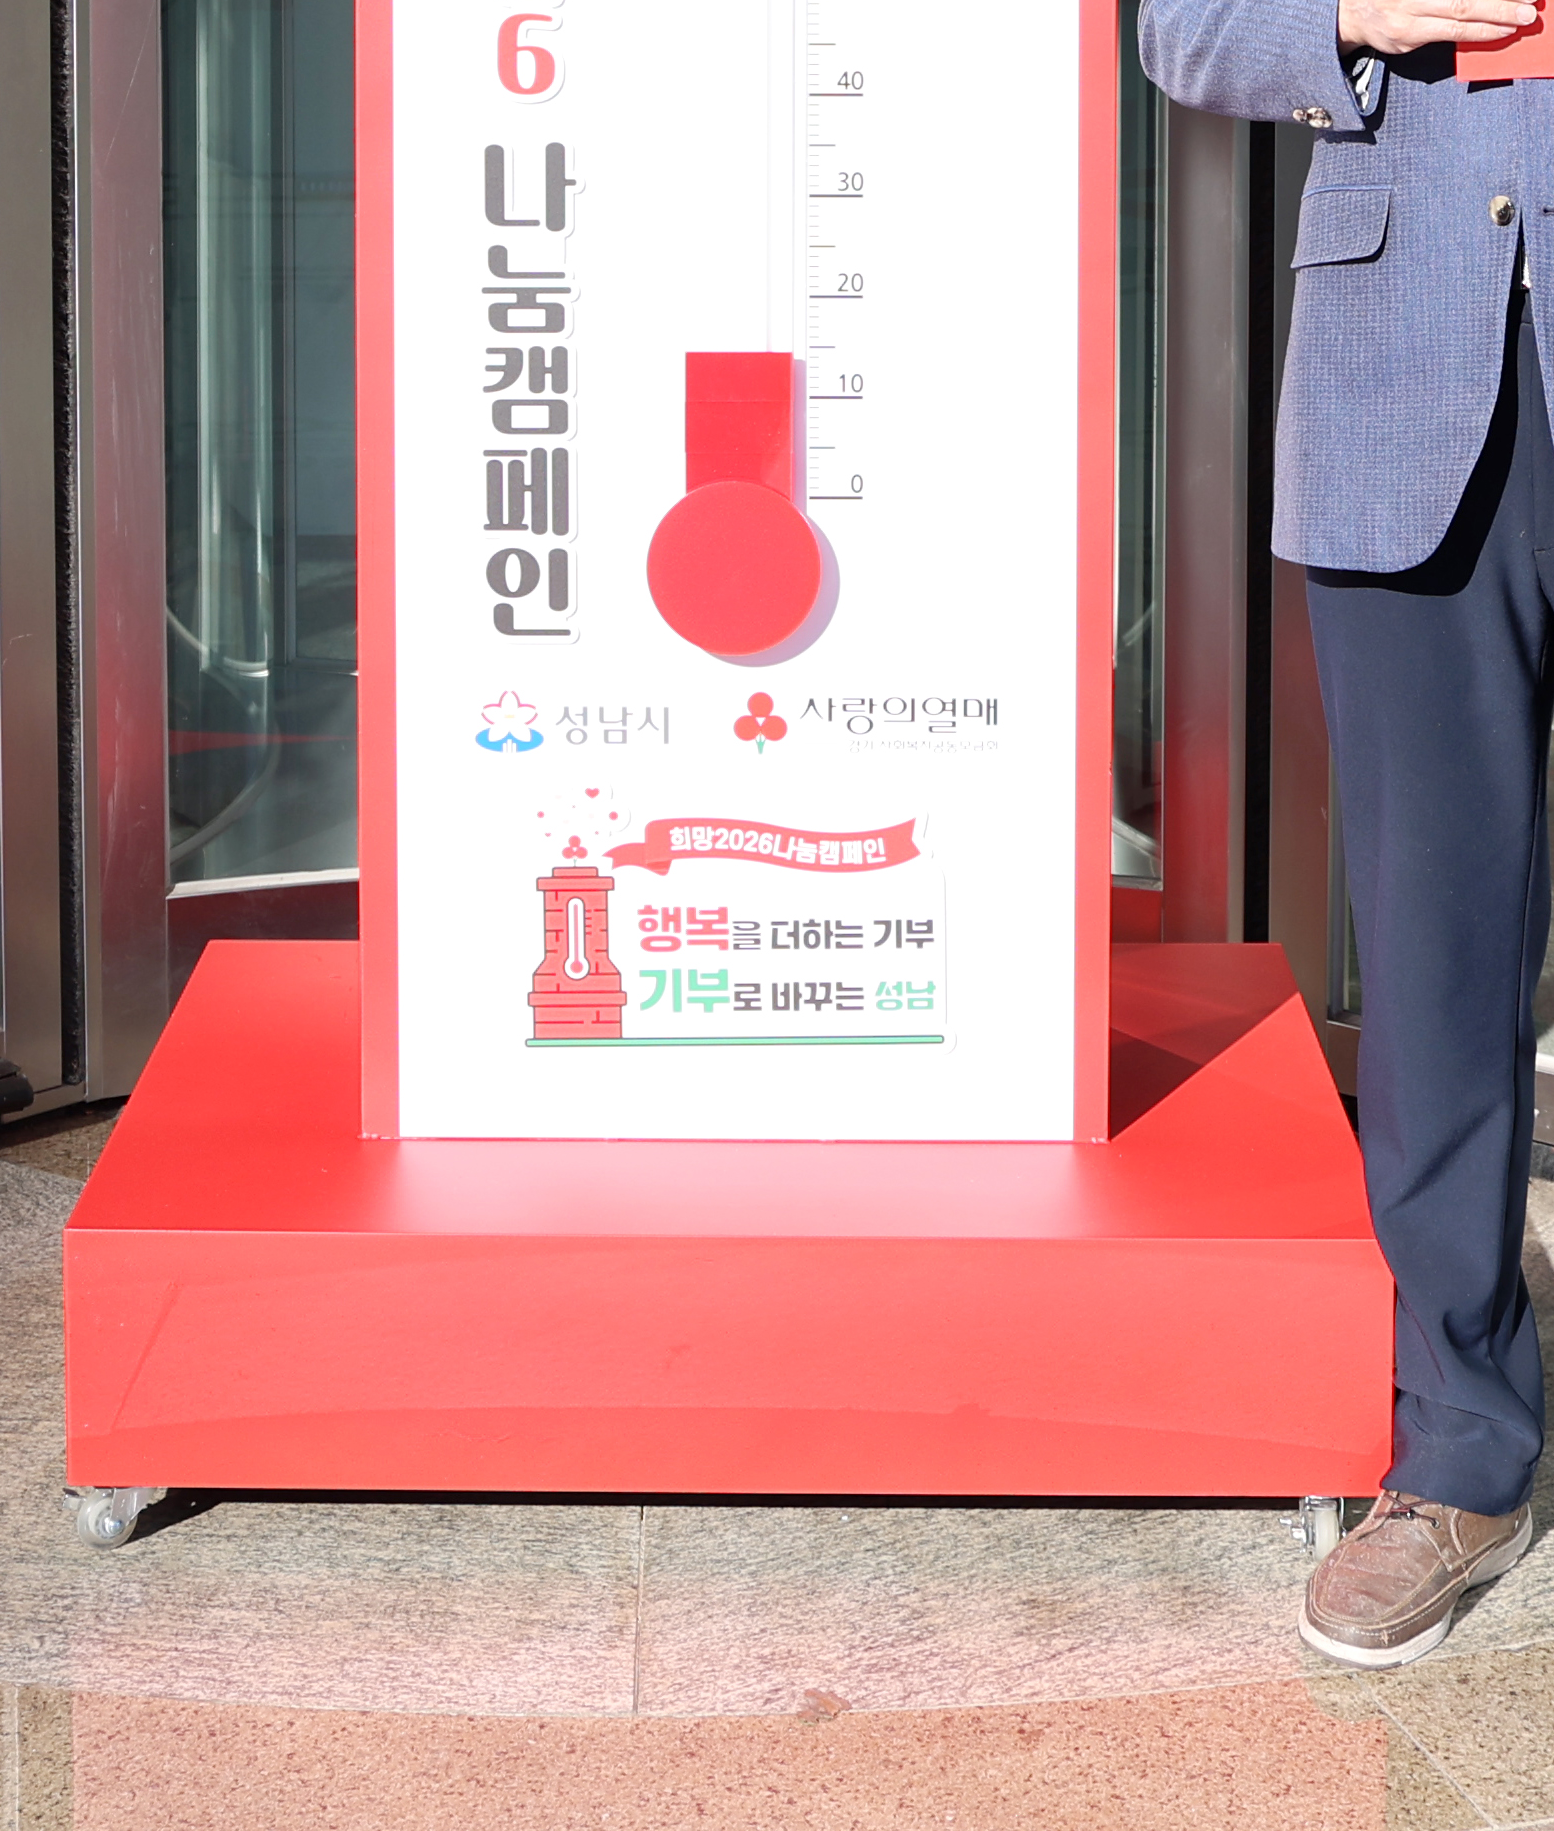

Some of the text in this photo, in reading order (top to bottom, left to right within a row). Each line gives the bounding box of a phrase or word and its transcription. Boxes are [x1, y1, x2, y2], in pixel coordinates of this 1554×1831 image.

[836, 71, 864, 91] 40
[836, 172, 864, 192] 30
[836, 273, 864, 293] 20
[481, 142, 577, 637] 나눔캠페인
[838, 374, 864, 393] 10
[850, 475, 863, 494] 0
[555, 705, 671, 746] 성남시
[799, 696, 999, 735] 사랑의열매
[669, 823, 887, 866] 희망2026나눔캠페인
[636, 905, 936, 953] 행복을 더하는 기부
[639, 967, 937, 1014] 기부로 바꾸는 성남
